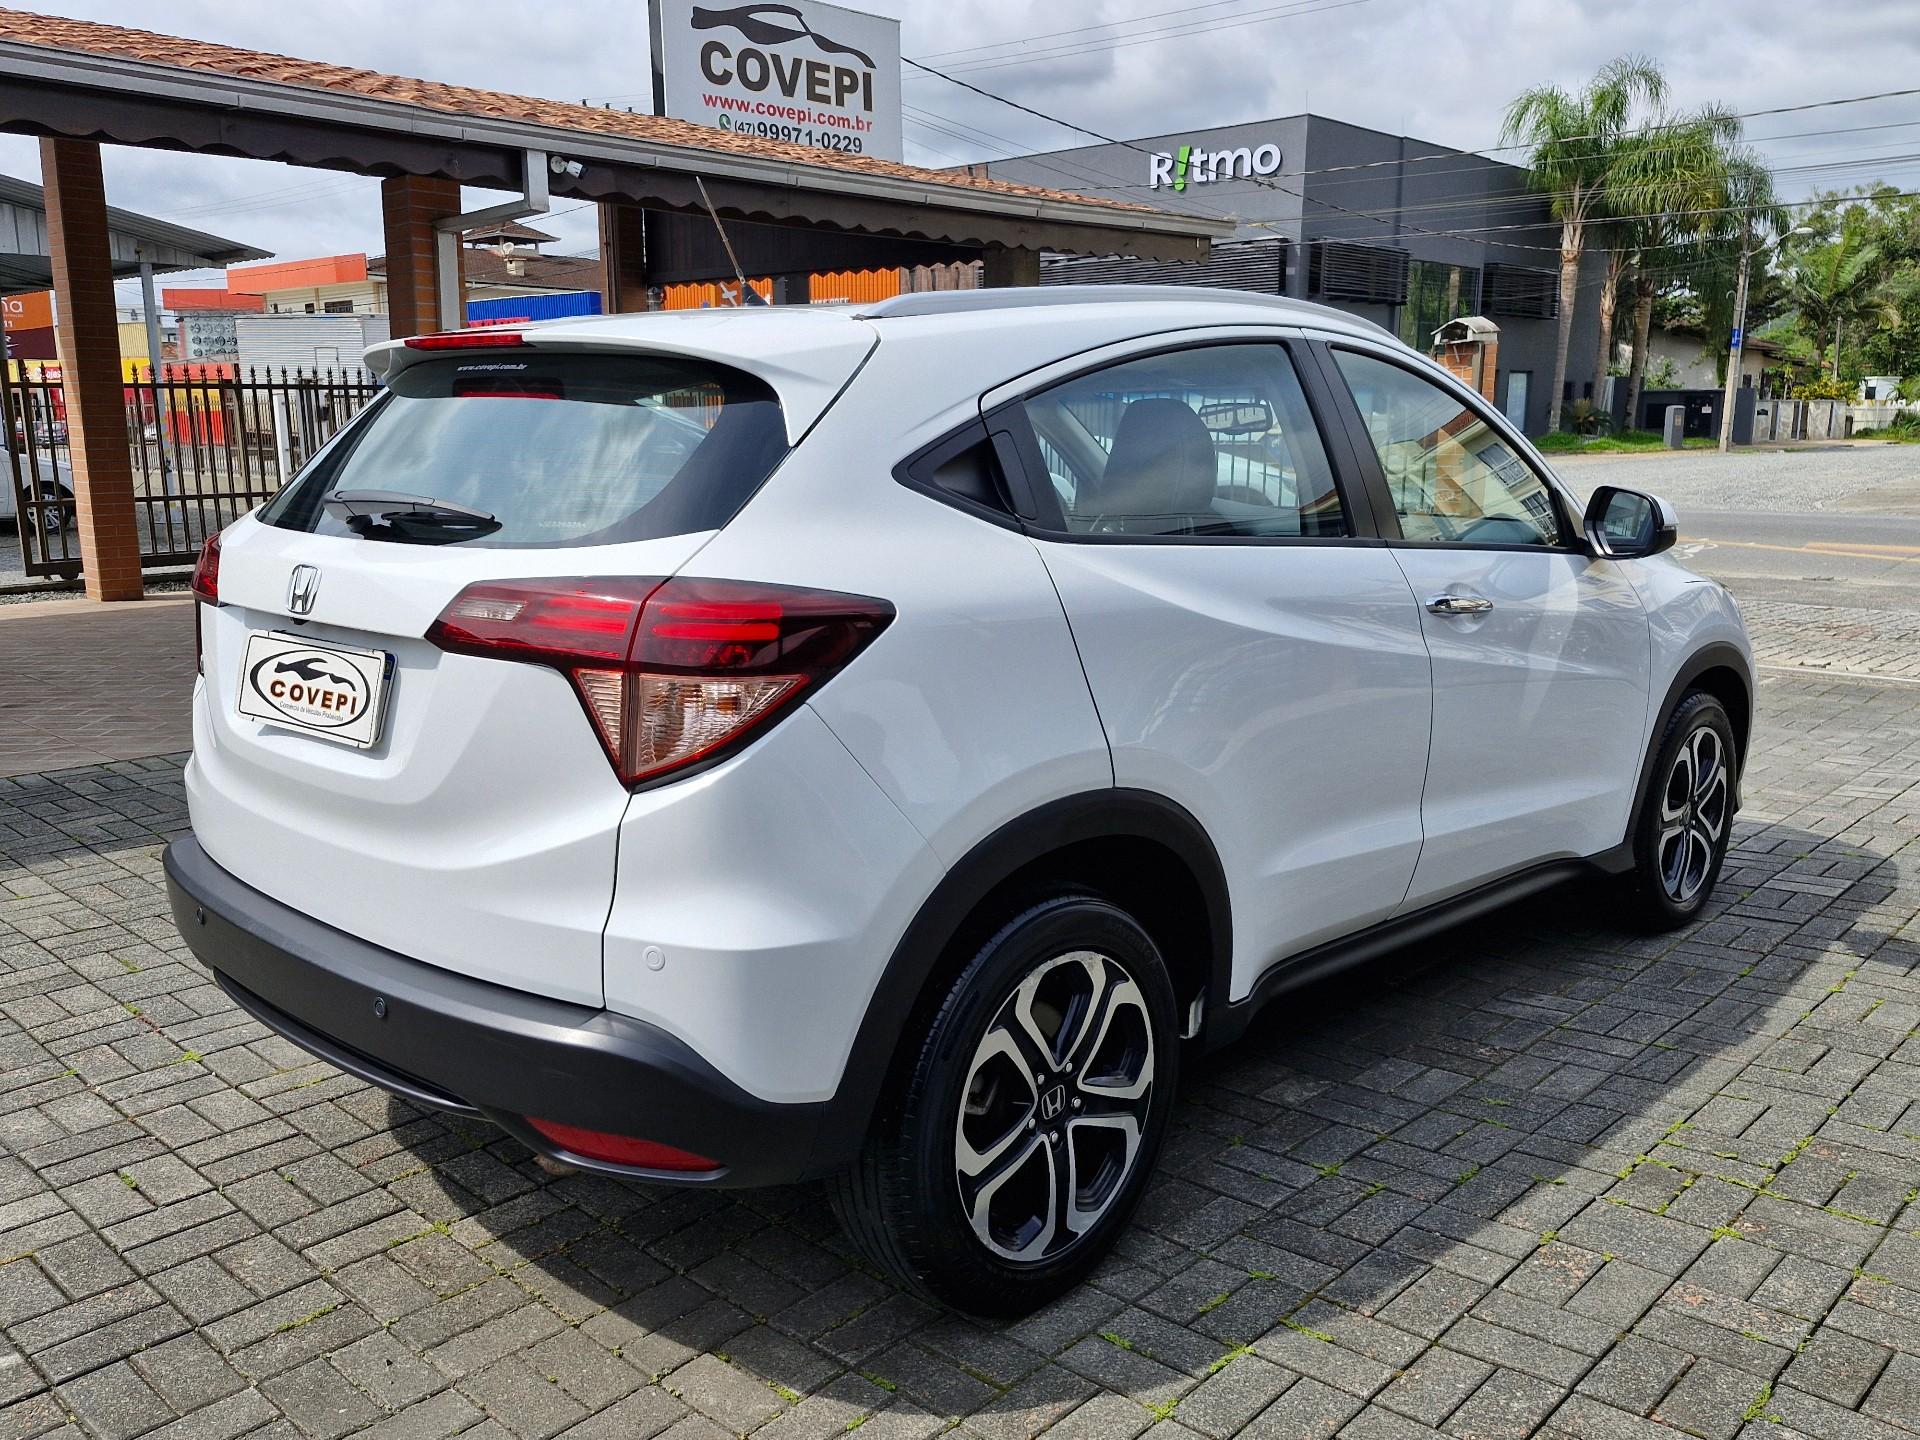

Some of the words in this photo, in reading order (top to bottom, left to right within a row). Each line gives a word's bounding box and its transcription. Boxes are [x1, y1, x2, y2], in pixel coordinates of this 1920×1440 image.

[701, 40, 873, 112] COVEPI
[702, 93, 872, 132] www.covepi.com.br
[270, 680, 357, 715] COVEPI
